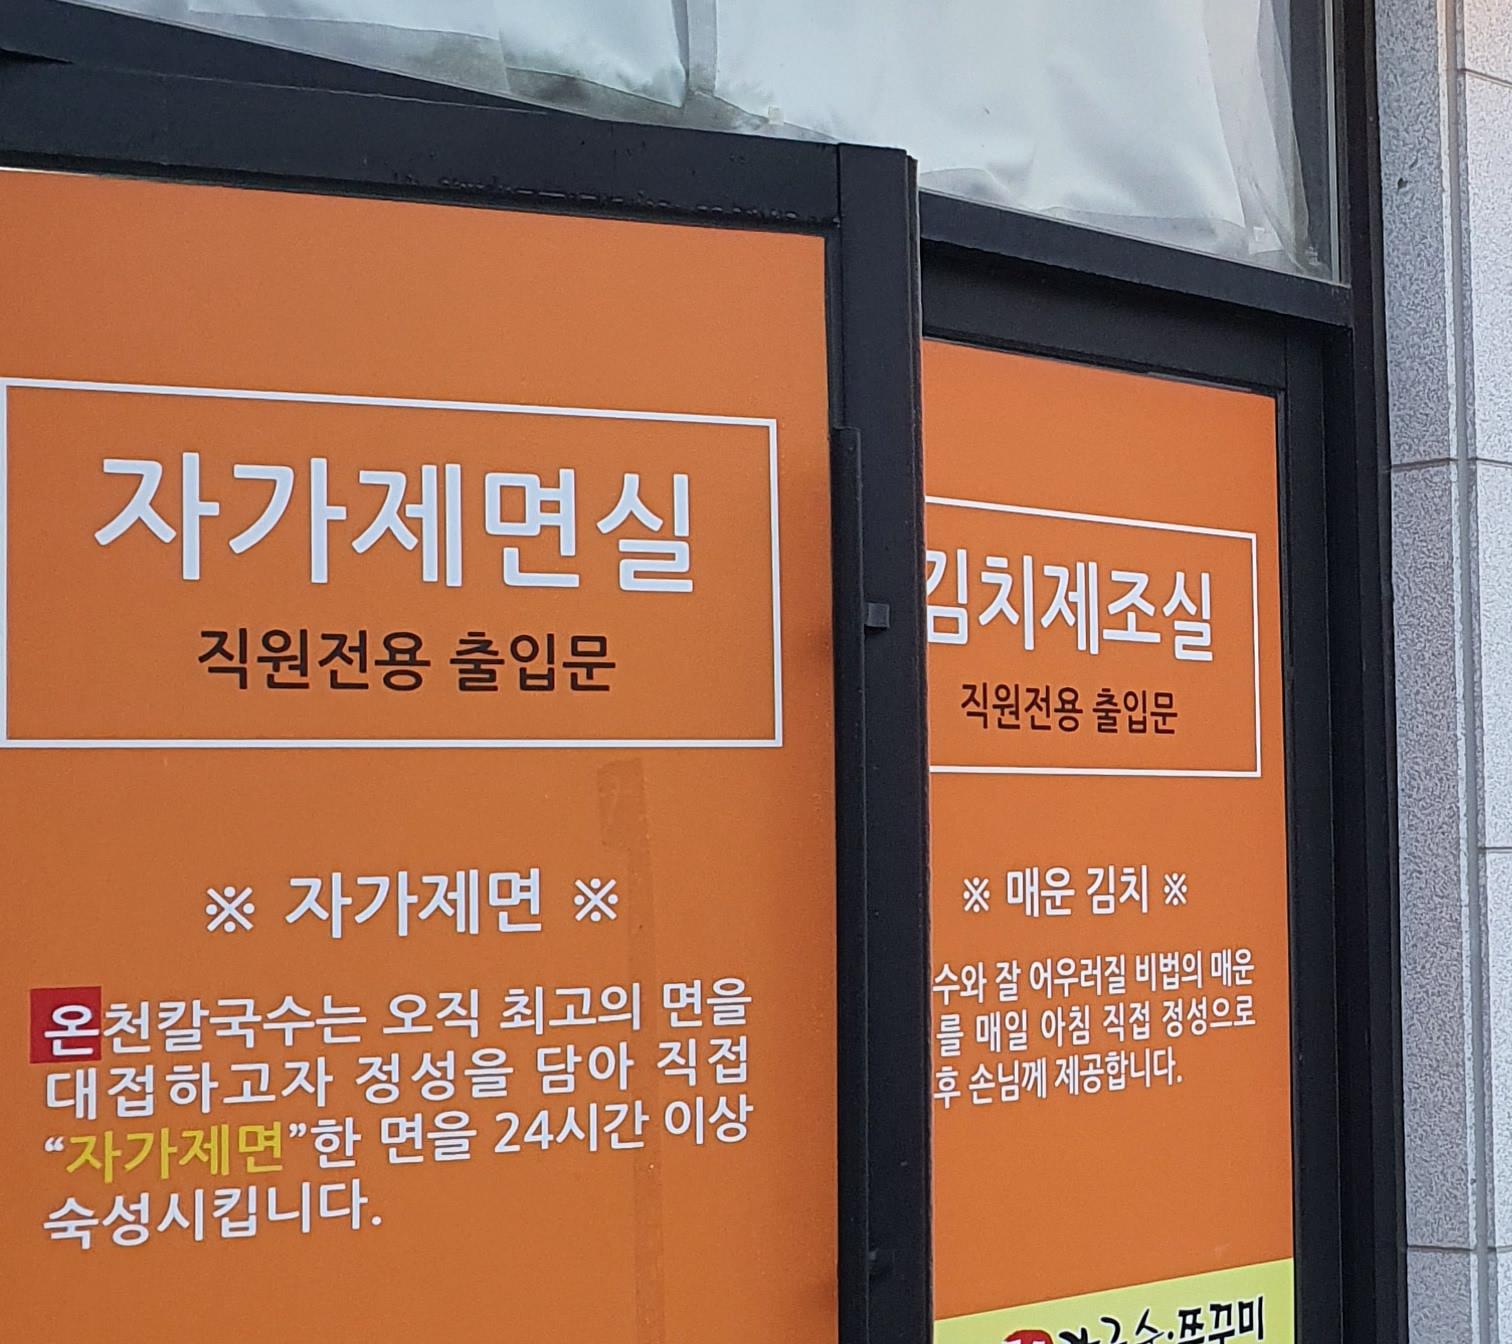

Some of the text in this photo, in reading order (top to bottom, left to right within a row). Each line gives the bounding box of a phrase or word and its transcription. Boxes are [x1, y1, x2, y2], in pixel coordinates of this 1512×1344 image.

[93, 451, 695, 593] 자가제면실
[926, 547, 1214, 662] 김치제조실
[198, 627, 617, 693] 직원전용 출입문
[961, 682, 1178, 734] 직원전용 출입문
[285, 867, 543, 940] 자가제면
[1006, 864, 1150, 918] 매운 김치
[995, 959, 1022, 1003] 잘
[1029, 954, 1127, 999] 어우러질
[1135, 950, 1203, 992] 비법의
[1210, 948, 1256, 988] 매운
[43, 976, 753, 1057] 온천칼국수는 오직 최고의 면을
[936, 994, 1257, 1058] 를 매일 아침 직접 정성으로
[46, 1035, 749, 1121] 대접하고자 정성을 담아 직접
[933, 1046, 1184, 1110] 후 손님께 제공합니다.
[381, 1109, 478, 1166] 면을
[494, 1099, 651, 1156] 24시간
[664, 1092, 754, 1146] 이상
[42, 1178, 383, 1251] 숙성시킵니다.
